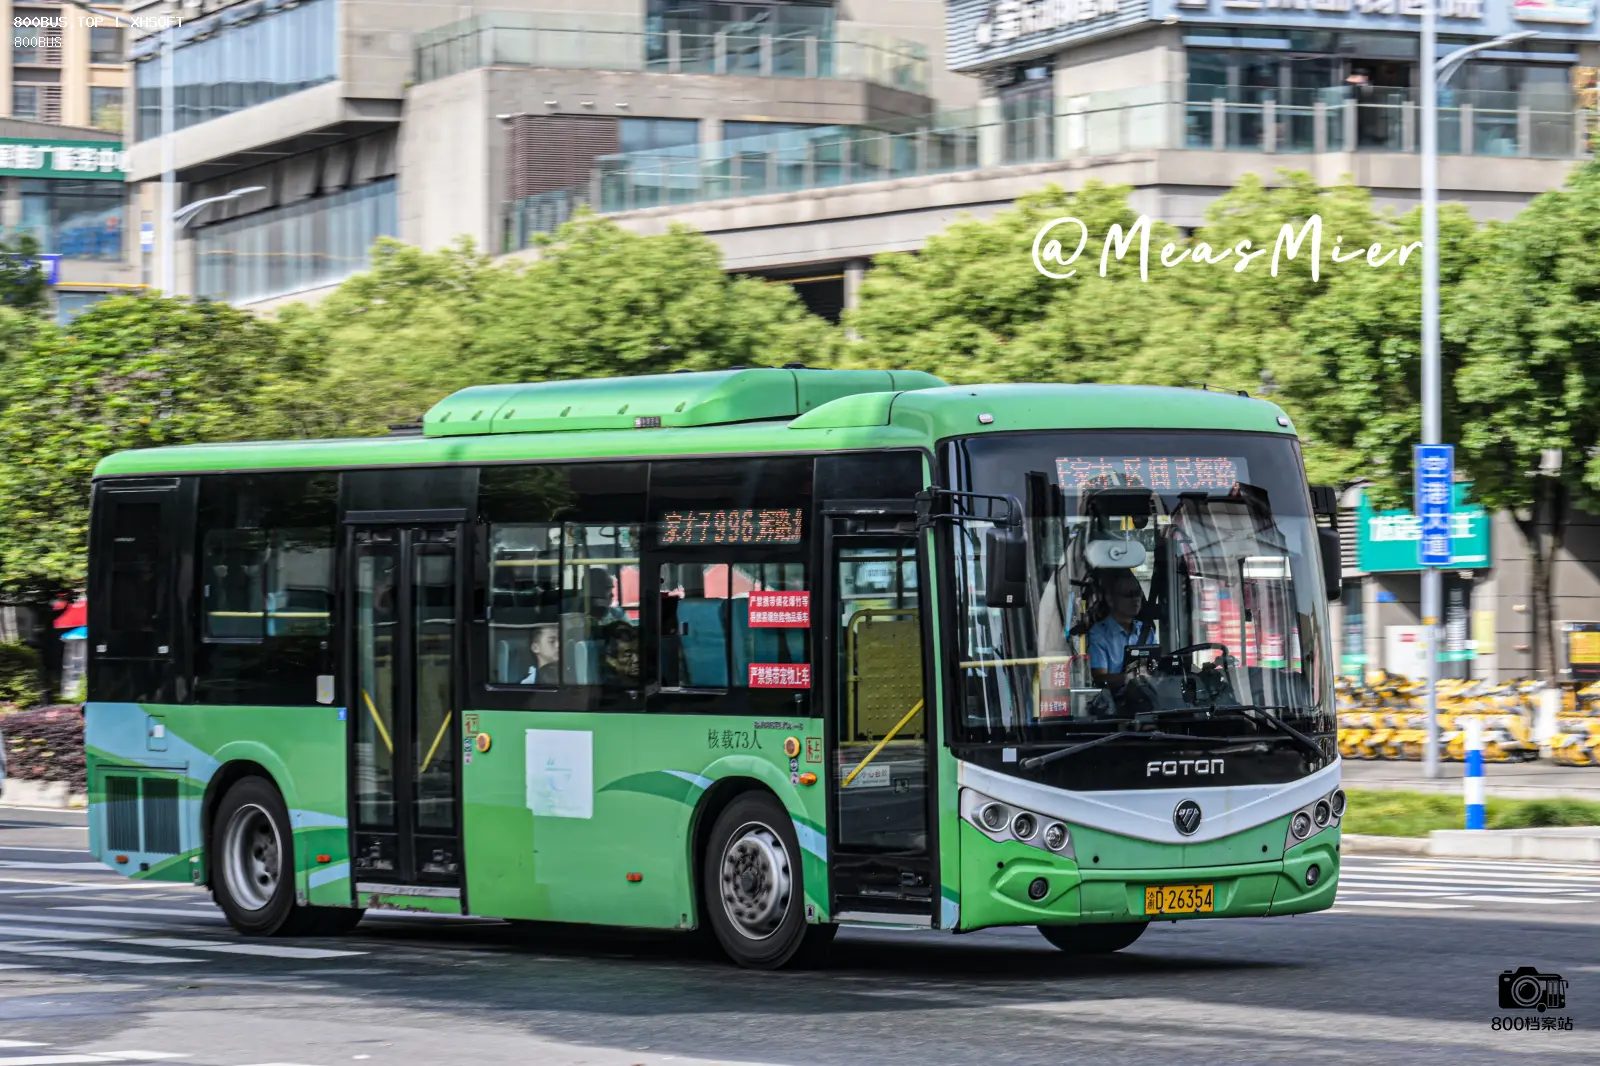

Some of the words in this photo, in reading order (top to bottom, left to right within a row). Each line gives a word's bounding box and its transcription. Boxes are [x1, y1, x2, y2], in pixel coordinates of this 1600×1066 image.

[749, 666, 810, 685] 严禁携带宠物上车
[707, 728, 762, 749] 核载73人
[1146, 759, 1225, 777] FOTON
